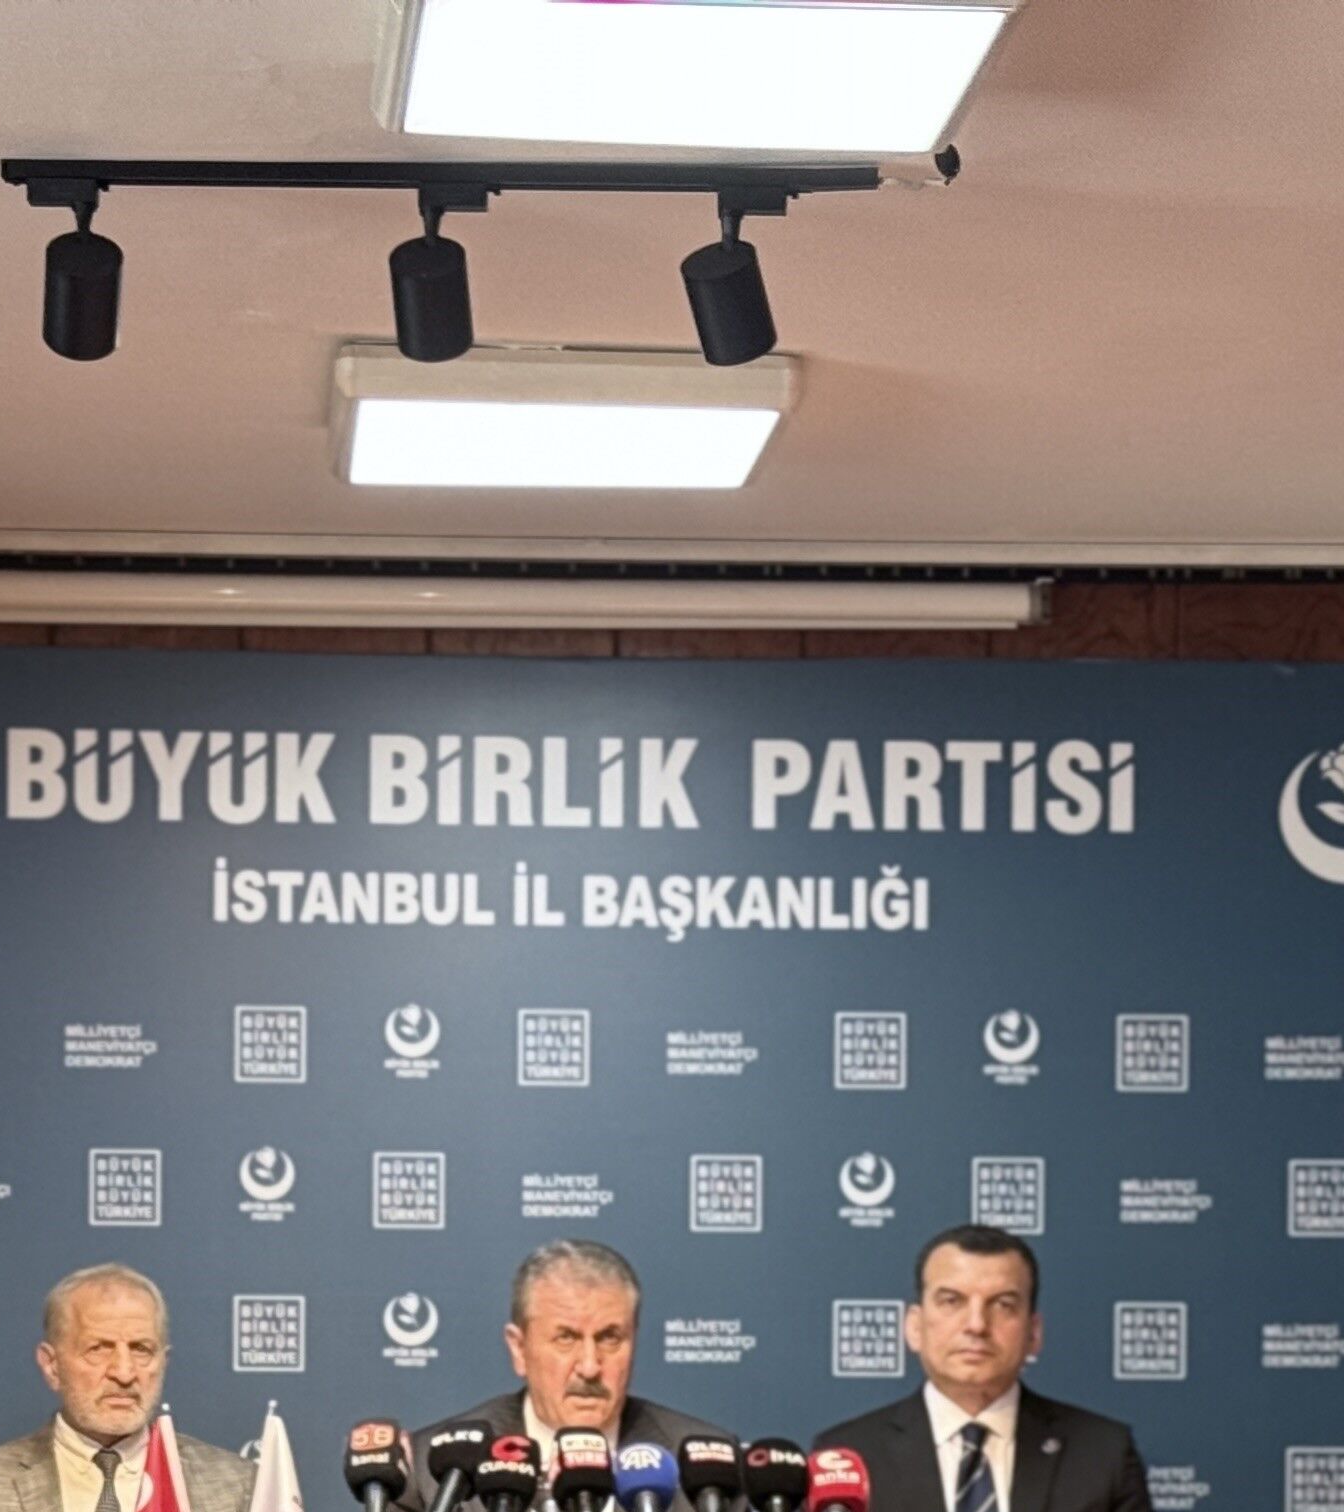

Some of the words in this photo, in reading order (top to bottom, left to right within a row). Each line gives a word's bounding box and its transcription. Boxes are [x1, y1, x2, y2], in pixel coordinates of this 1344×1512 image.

[6, 728, 337, 825] BÜYÜK
[368, 733, 700, 829] BİRLİK
[750, 738, 1136, 834] PARTİSİ
[212, 856, 494, 925] İSTANBUL
[512, 862, 566, 926] İL
[582, 864, 931, 943] BAŞKANLIĞI
